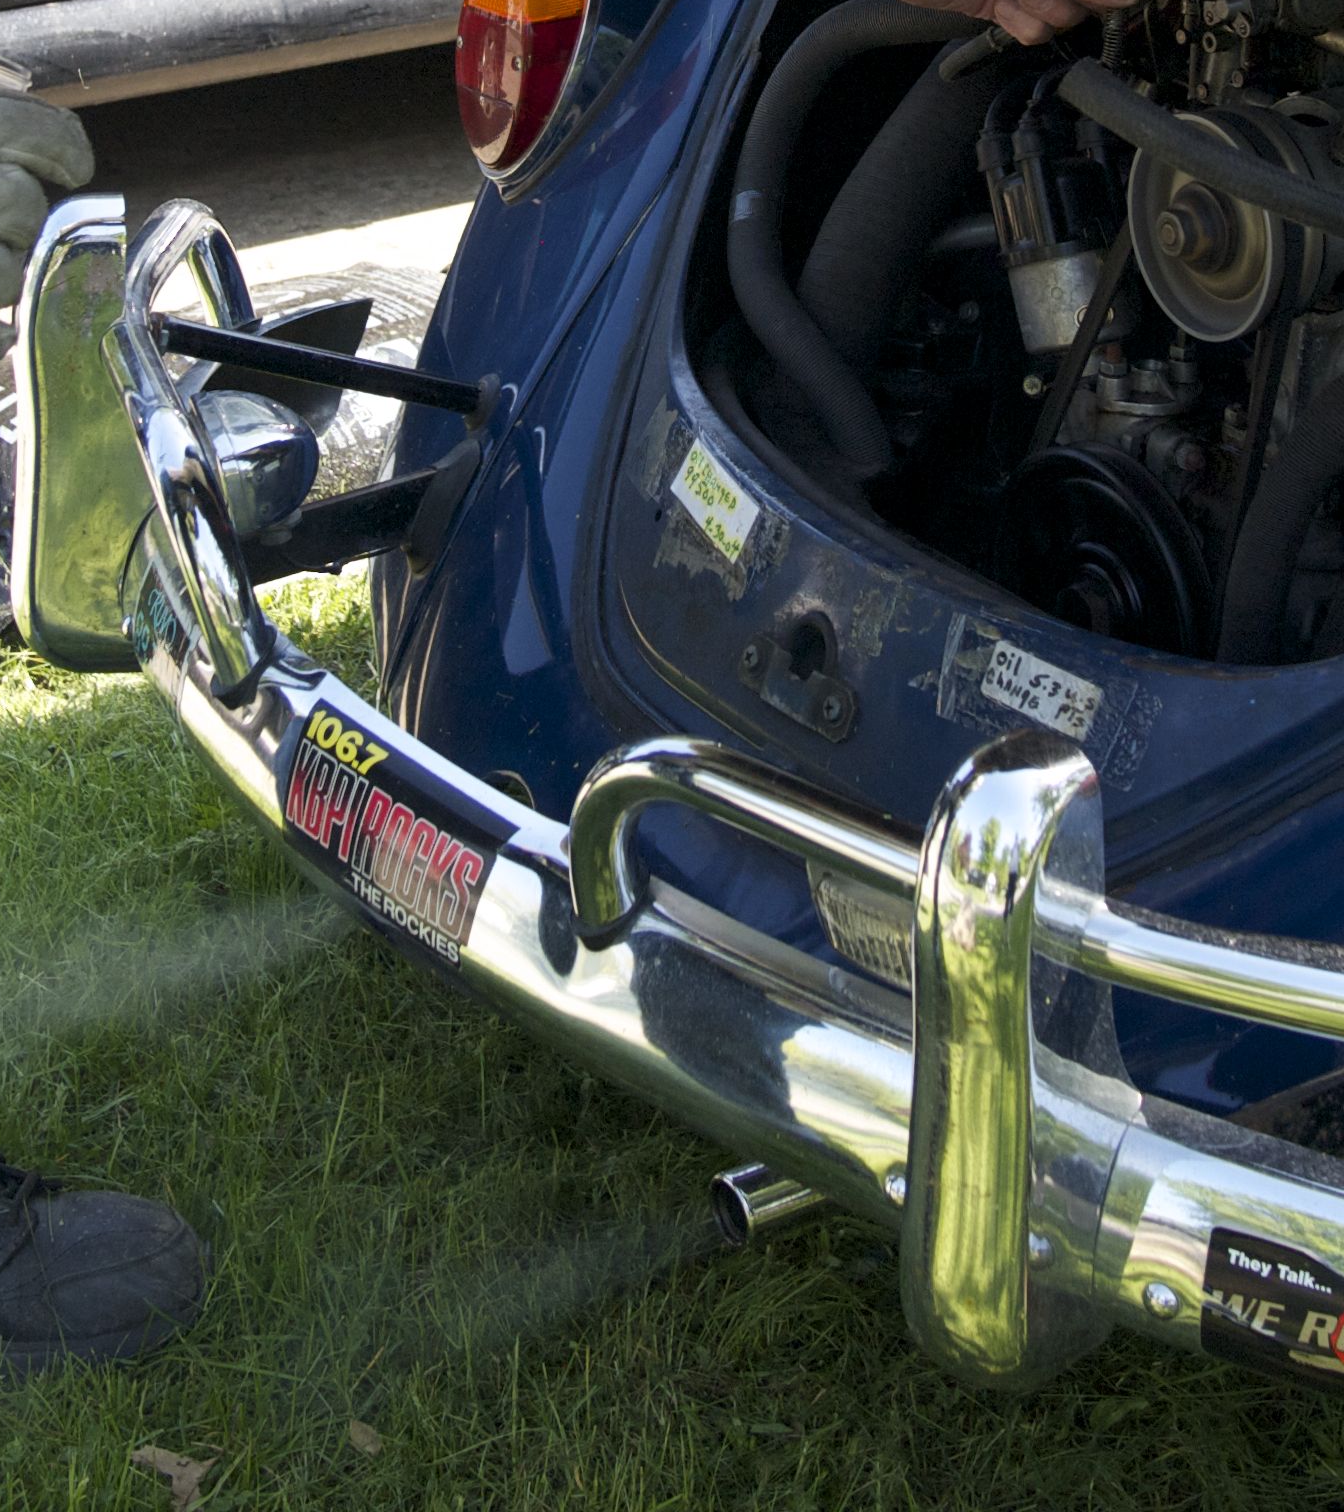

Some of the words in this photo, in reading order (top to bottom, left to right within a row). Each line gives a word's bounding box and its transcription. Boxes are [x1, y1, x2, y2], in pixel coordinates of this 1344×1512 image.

[996, 651, 1022, 676] Oil
[306, 709, 389, 776] 106.7
[286, 739, 369, 863] KBPI
[351, 786, 484, 939] ROCKS
[350, 873, 383, 909] THE
[383, 897, 459, 963] ROCKIES
[1228, 1248, 1272, 1278] They
